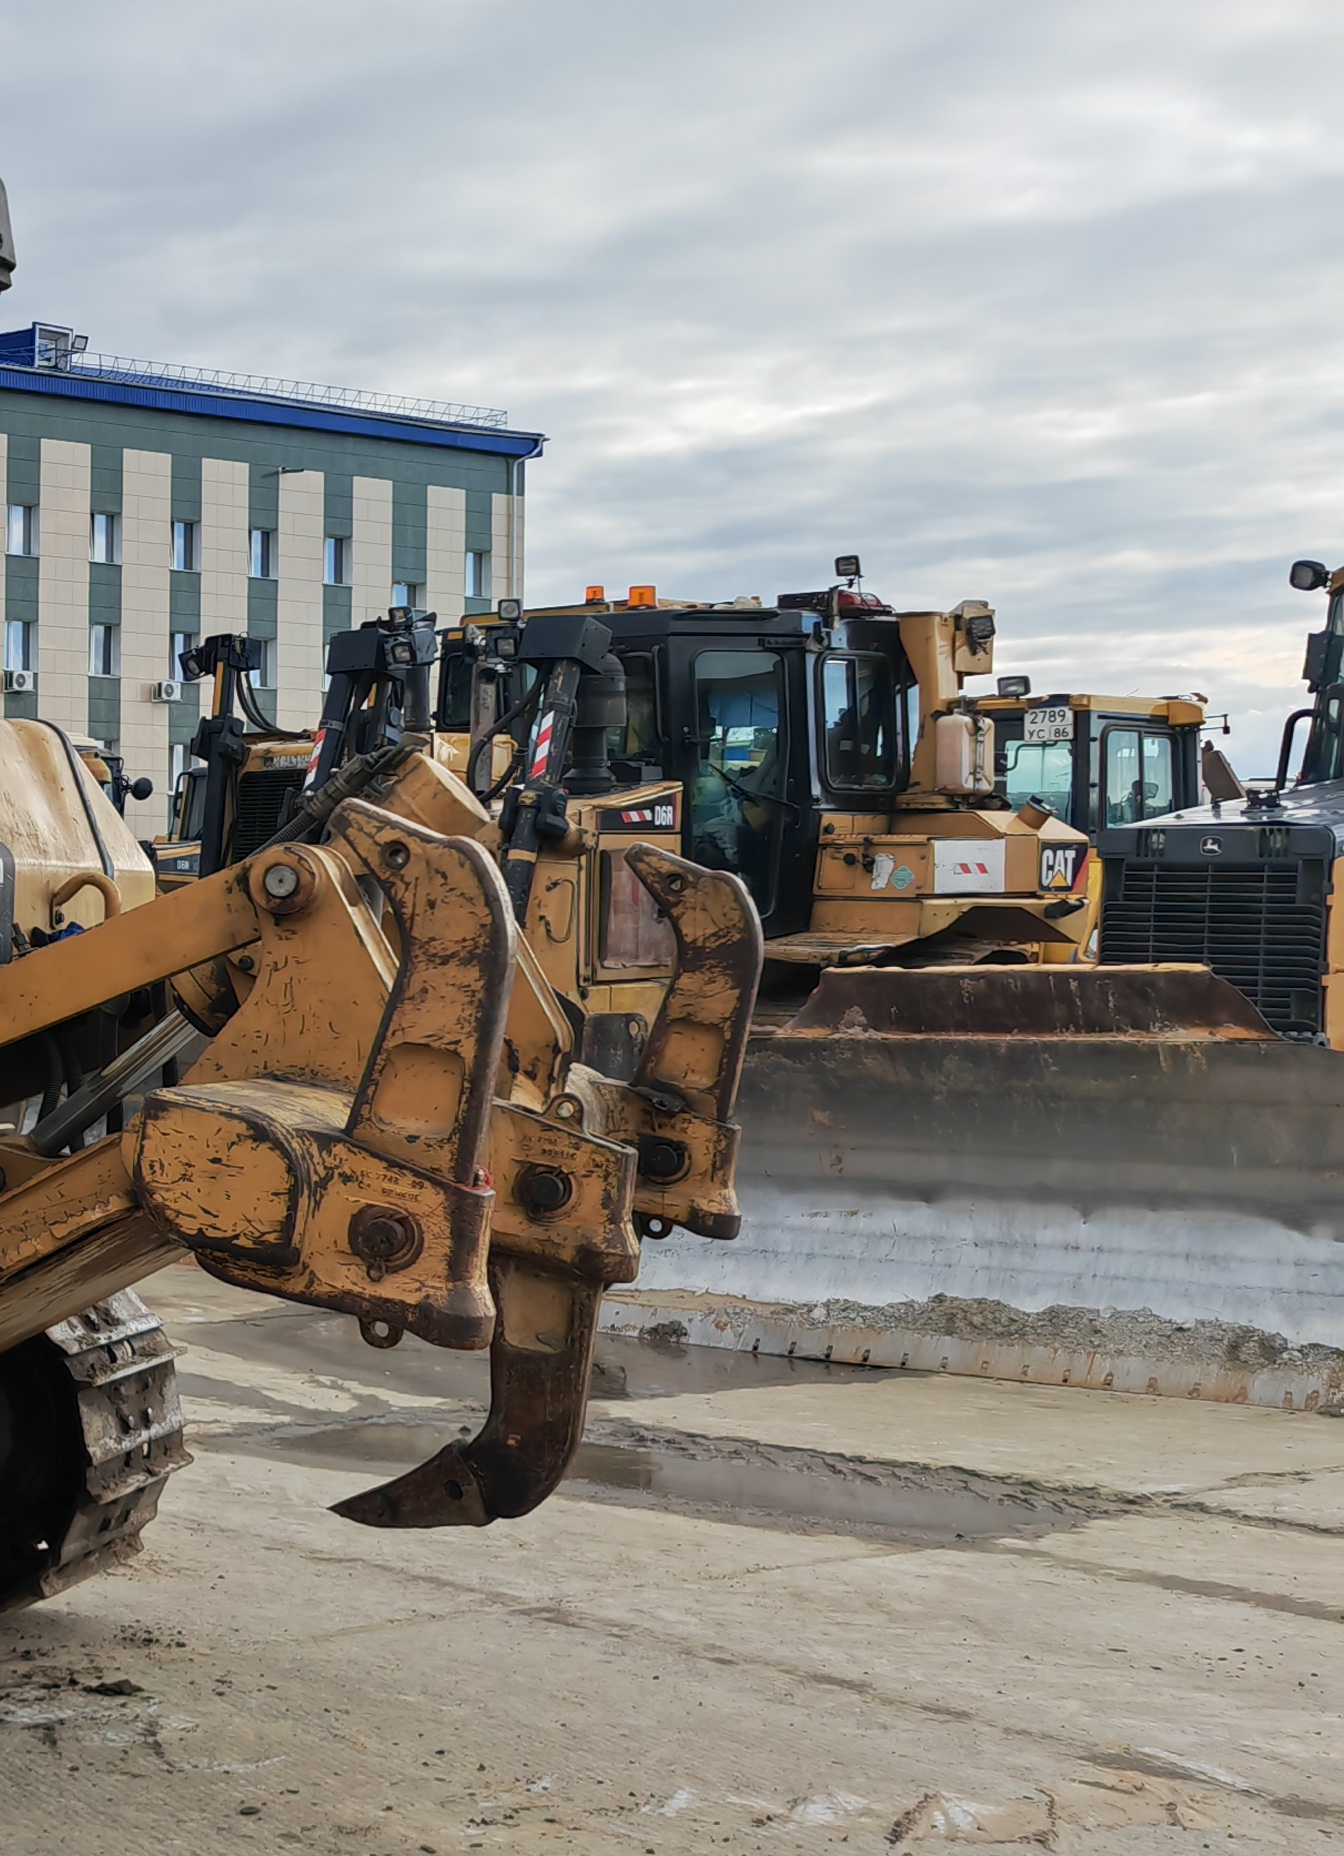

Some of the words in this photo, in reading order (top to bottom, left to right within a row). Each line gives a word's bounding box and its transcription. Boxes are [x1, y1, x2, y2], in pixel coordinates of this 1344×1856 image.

[1029, 709, 1067, 725] 2789
[1053, 727, 1070, 738] 86
[654, 805, 674, 826] D6R
[1041, 848, 1077, 887] CAT
